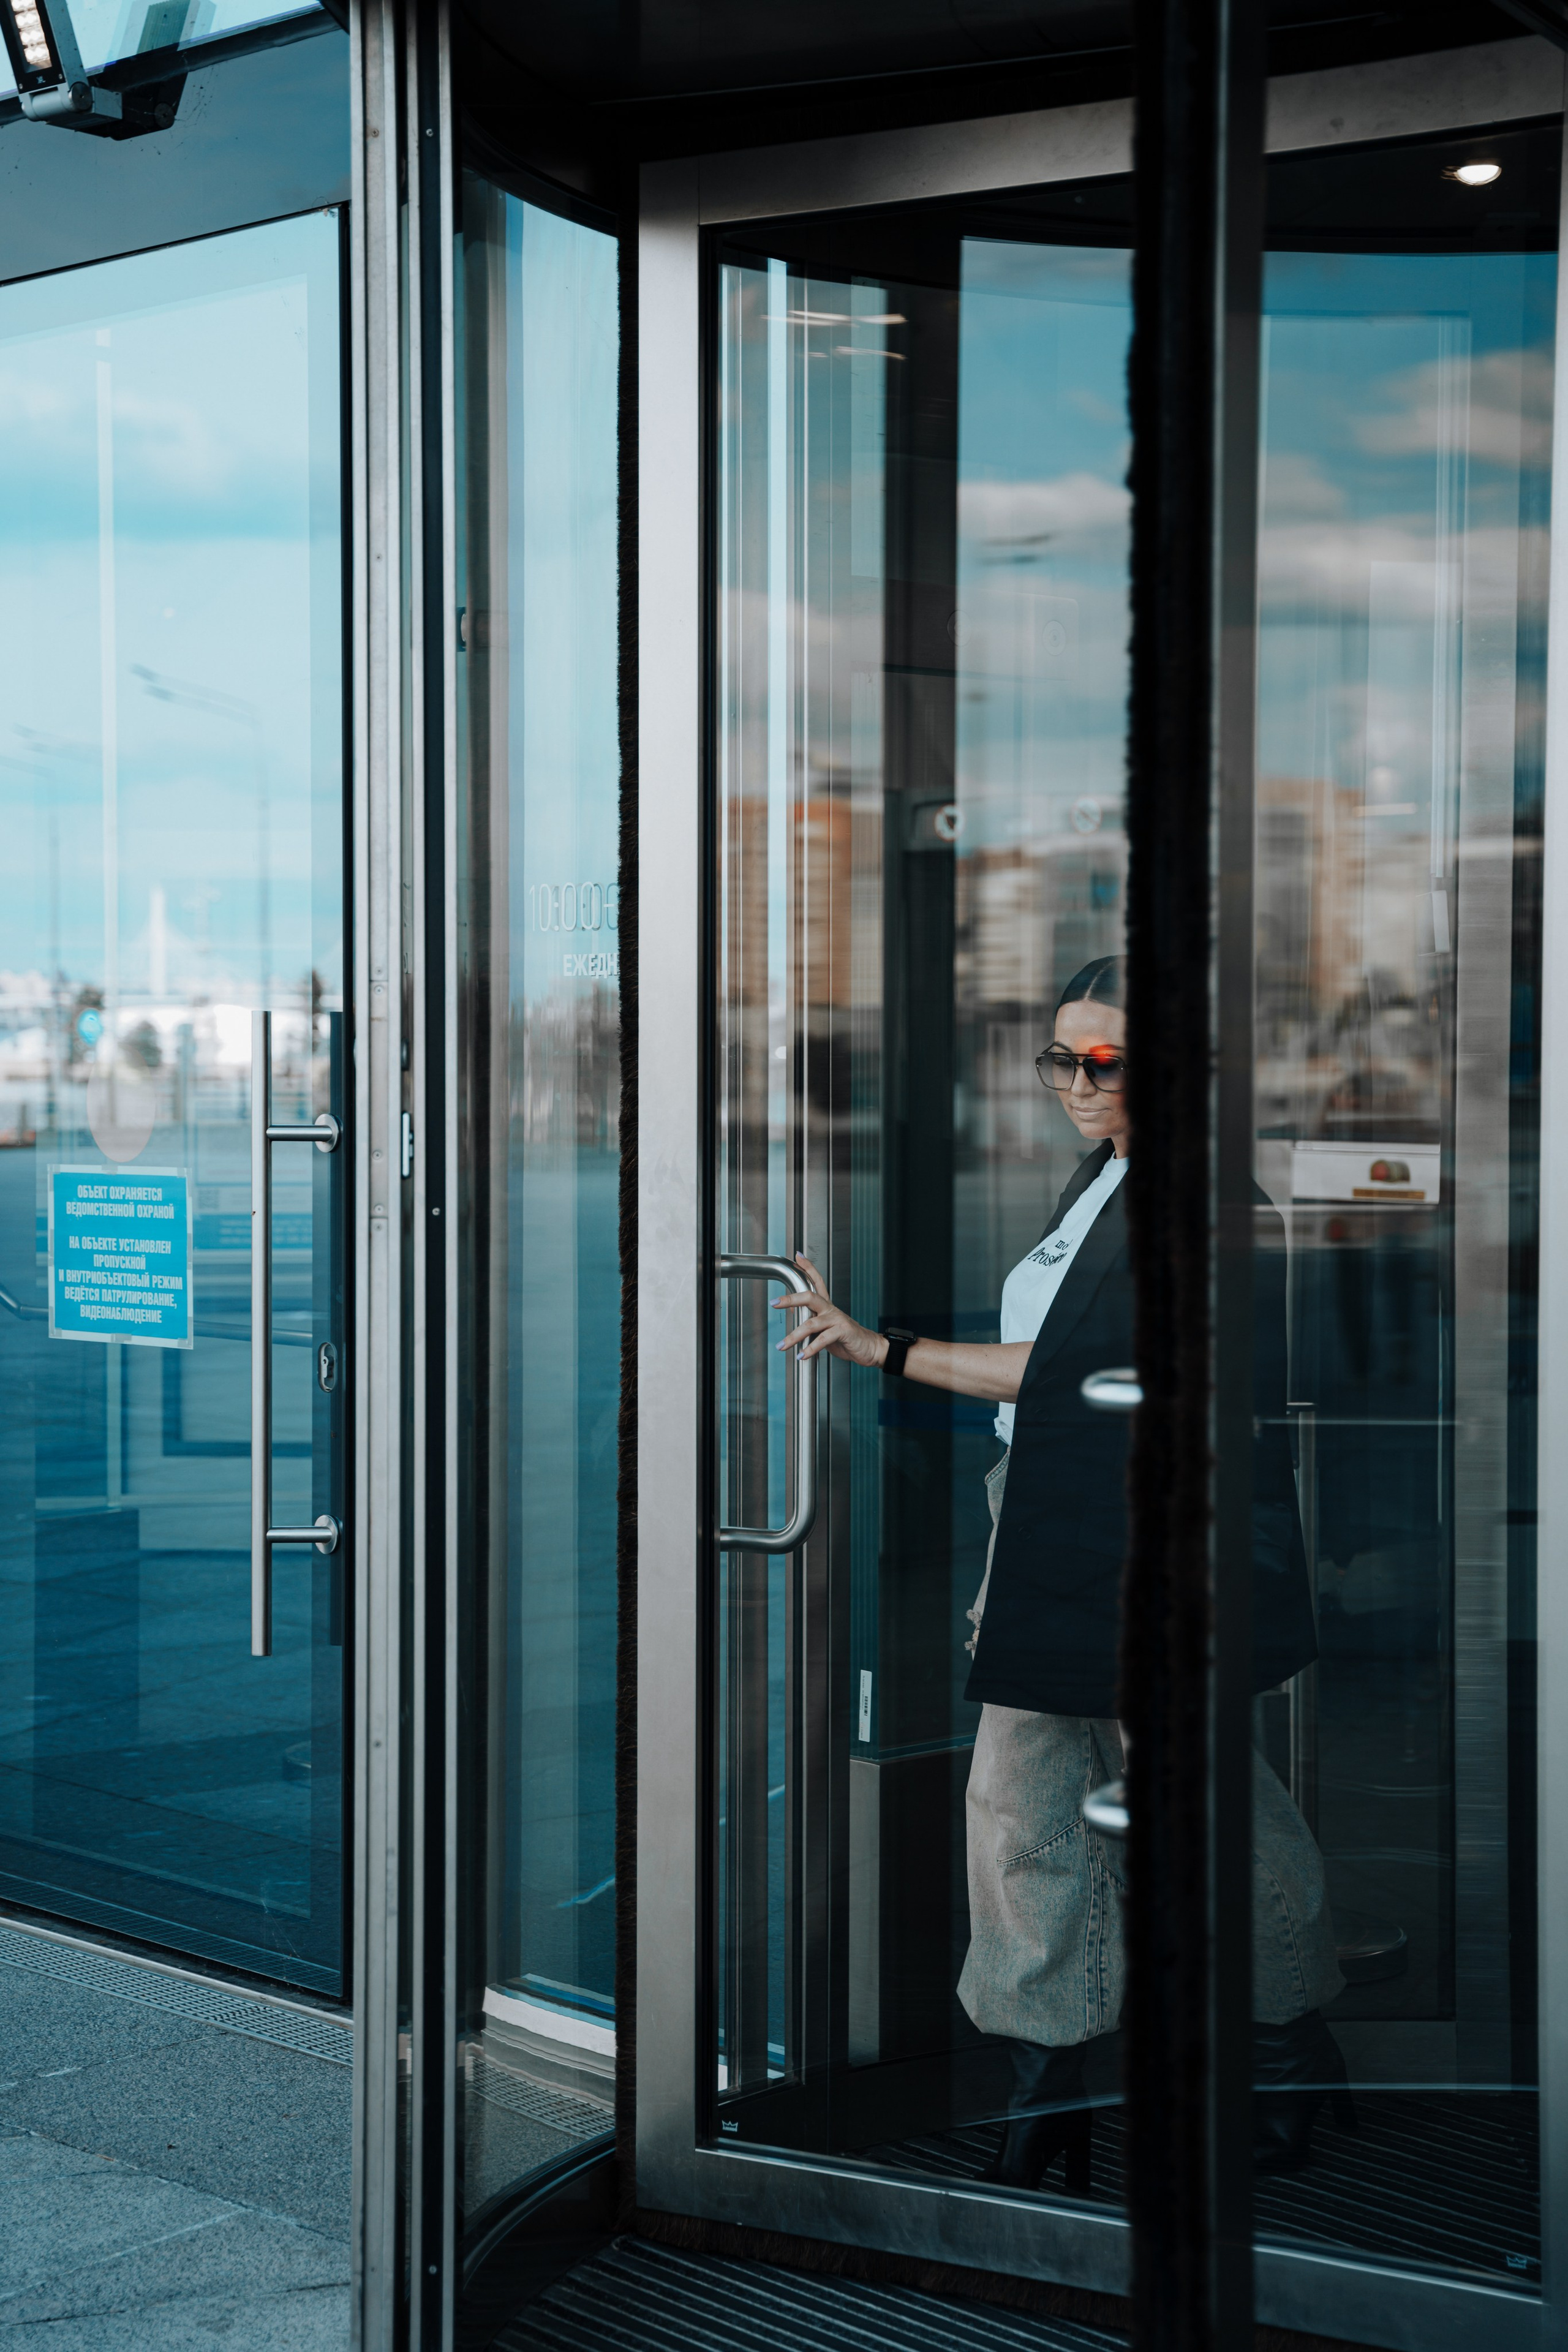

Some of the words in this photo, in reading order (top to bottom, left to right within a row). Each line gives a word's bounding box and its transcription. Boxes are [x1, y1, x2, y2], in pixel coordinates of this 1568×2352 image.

[562, 952, 618, 979] ЕЖЕДН
[77, 1185, 108, 1199] ОБЪЕКТ
[109, 1186, 163, 1201] ОХРАНЯЕТСЯ
[66, 1201, 135, 1218] ВЕДОМСТВЕННОЙ
[137, 1203, 175, 1219] ОХРАНОЙ
[69, 1235, 80, 1249] НА
[81, 1236, 117, 1251] ОБЪЕКТЕ
[119, 1238, 172, 1254] УСТАНОВЛЕН
[1055, 1239, 1069, 1251] mo
[93, 1254, 146, 1270] ПРОПУСКНОЙ
[58, 1269, 64, 1282] И
[66, 1269, 150, 1288] ВНУТРИОБЪЕКТОВЫЙ
[152, 1275, 183, 1290] РЕЖИМ
[64, 1285, 100, 1303] ВЕДЁТСЯ
[102, 1288, 178, 1310] ПАТРУЛИРОВАНИЕ,
[80, 1304, 162, 1324] ВИДЕОНАБЛЮДЕНИЕ
